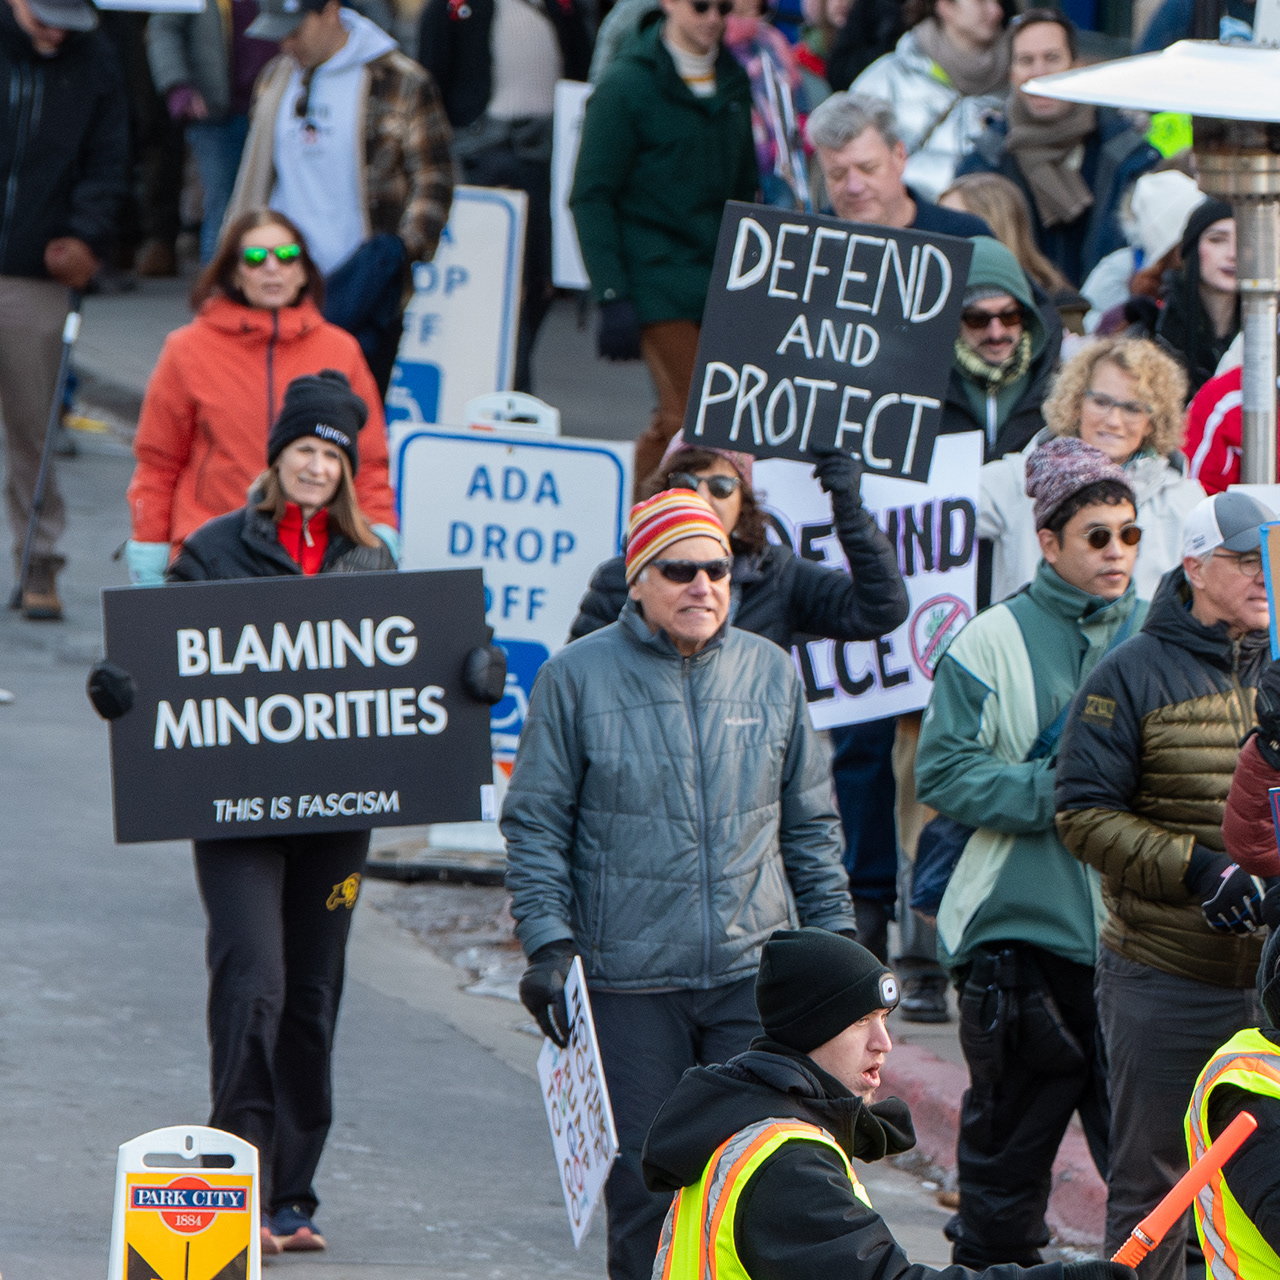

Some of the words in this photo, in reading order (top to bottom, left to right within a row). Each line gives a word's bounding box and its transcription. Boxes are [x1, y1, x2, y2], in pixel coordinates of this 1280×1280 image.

[726, 217, 953, 323] DEFEND
[776, 314, 880, 367] AND
[694, 361, 941, 475] PROTECT
[467, 464, 562, 506] ADA
[449, 521, 576, 565] DROP
[176, 615, 419, 677] BLAMING
[153, 684, 449, 750] MINORITIES
[213, 797, 264, 823] THIS
[269, 795, 292, 821] IS
[297, 790, 401, 819] FASCISM
[136, 1189, 188, 1206] PARK
[191, 1189, 242, 1207] CITY
[174, 1214, 202, 1227] 1884
